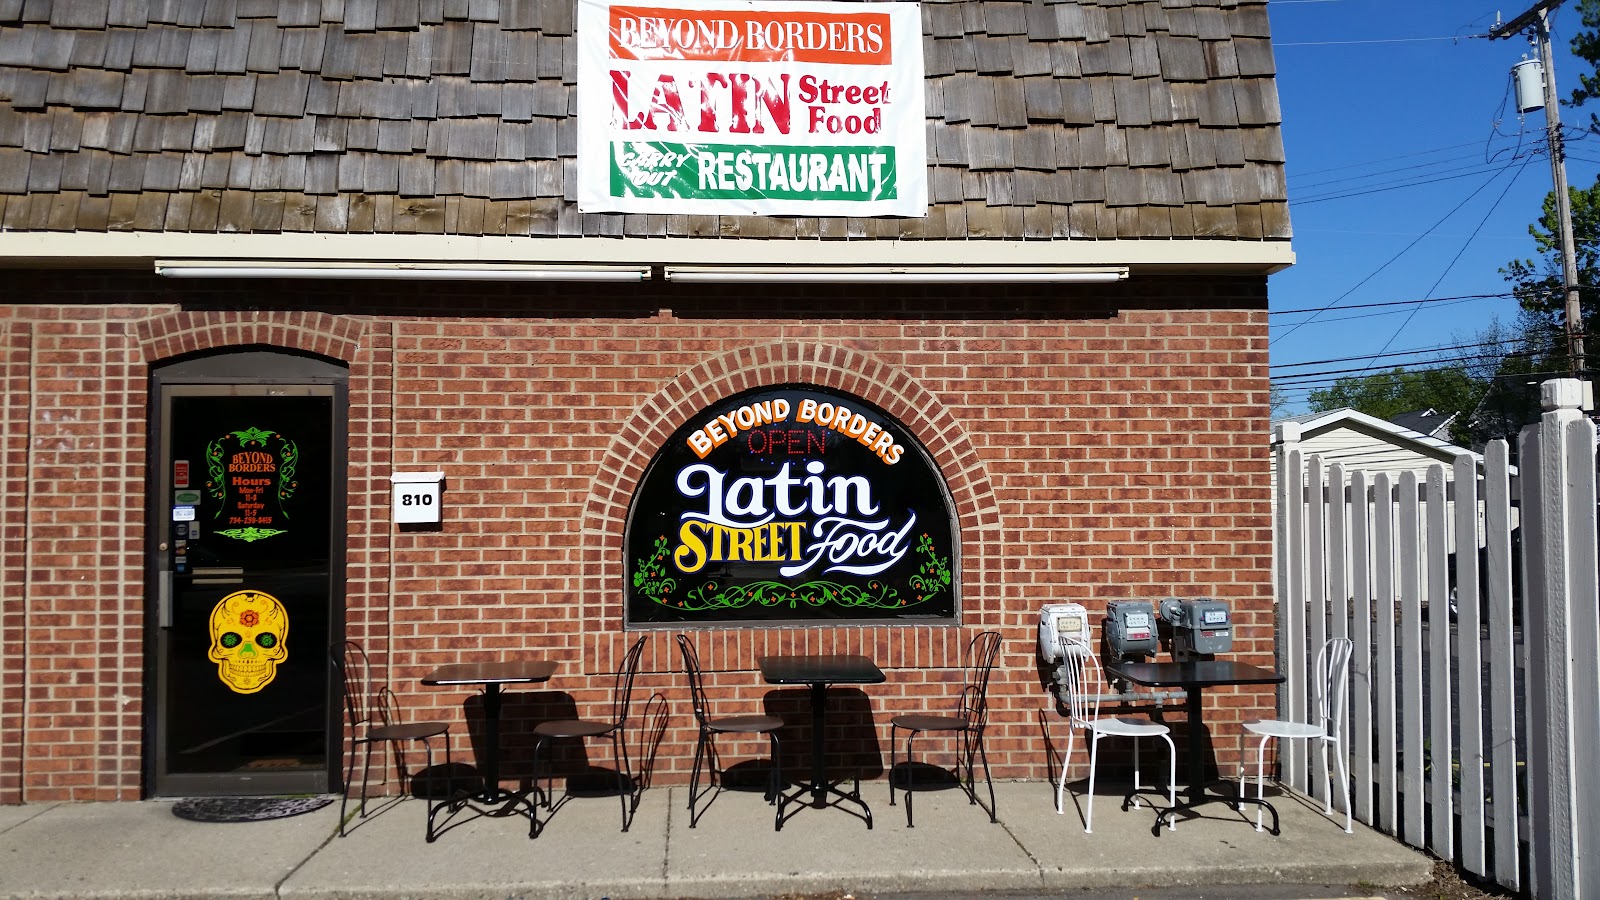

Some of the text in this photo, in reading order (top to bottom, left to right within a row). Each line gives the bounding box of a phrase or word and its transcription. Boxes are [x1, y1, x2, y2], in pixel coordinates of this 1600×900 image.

[618, 17, 884, 54] BEYOND BORDERS
[609, 69, 791, 134] LATIN
[798, 74, 892, 105] Street
[807, 106, 882, 134] Food
[620, 151, 692, 168] CARRY
[698, 151, 887, 193] RESTAURANT
[632, 169, 678, 187] OUT
[687, 398, 905, 466] BEYOND BORDERS
[747, 429, 826, 455] OPEN
[228, 463, 276, 472] BORDERS
[232, 451, 273, 464] BEYOND
[232, 477, 271, 486] Hours
[676, 460, 880, 528] Latin
[237, 501, 265, 509] Saturday
[402, 494, 433, 506] 810
[673, 508, 917, 578] STREET Food
